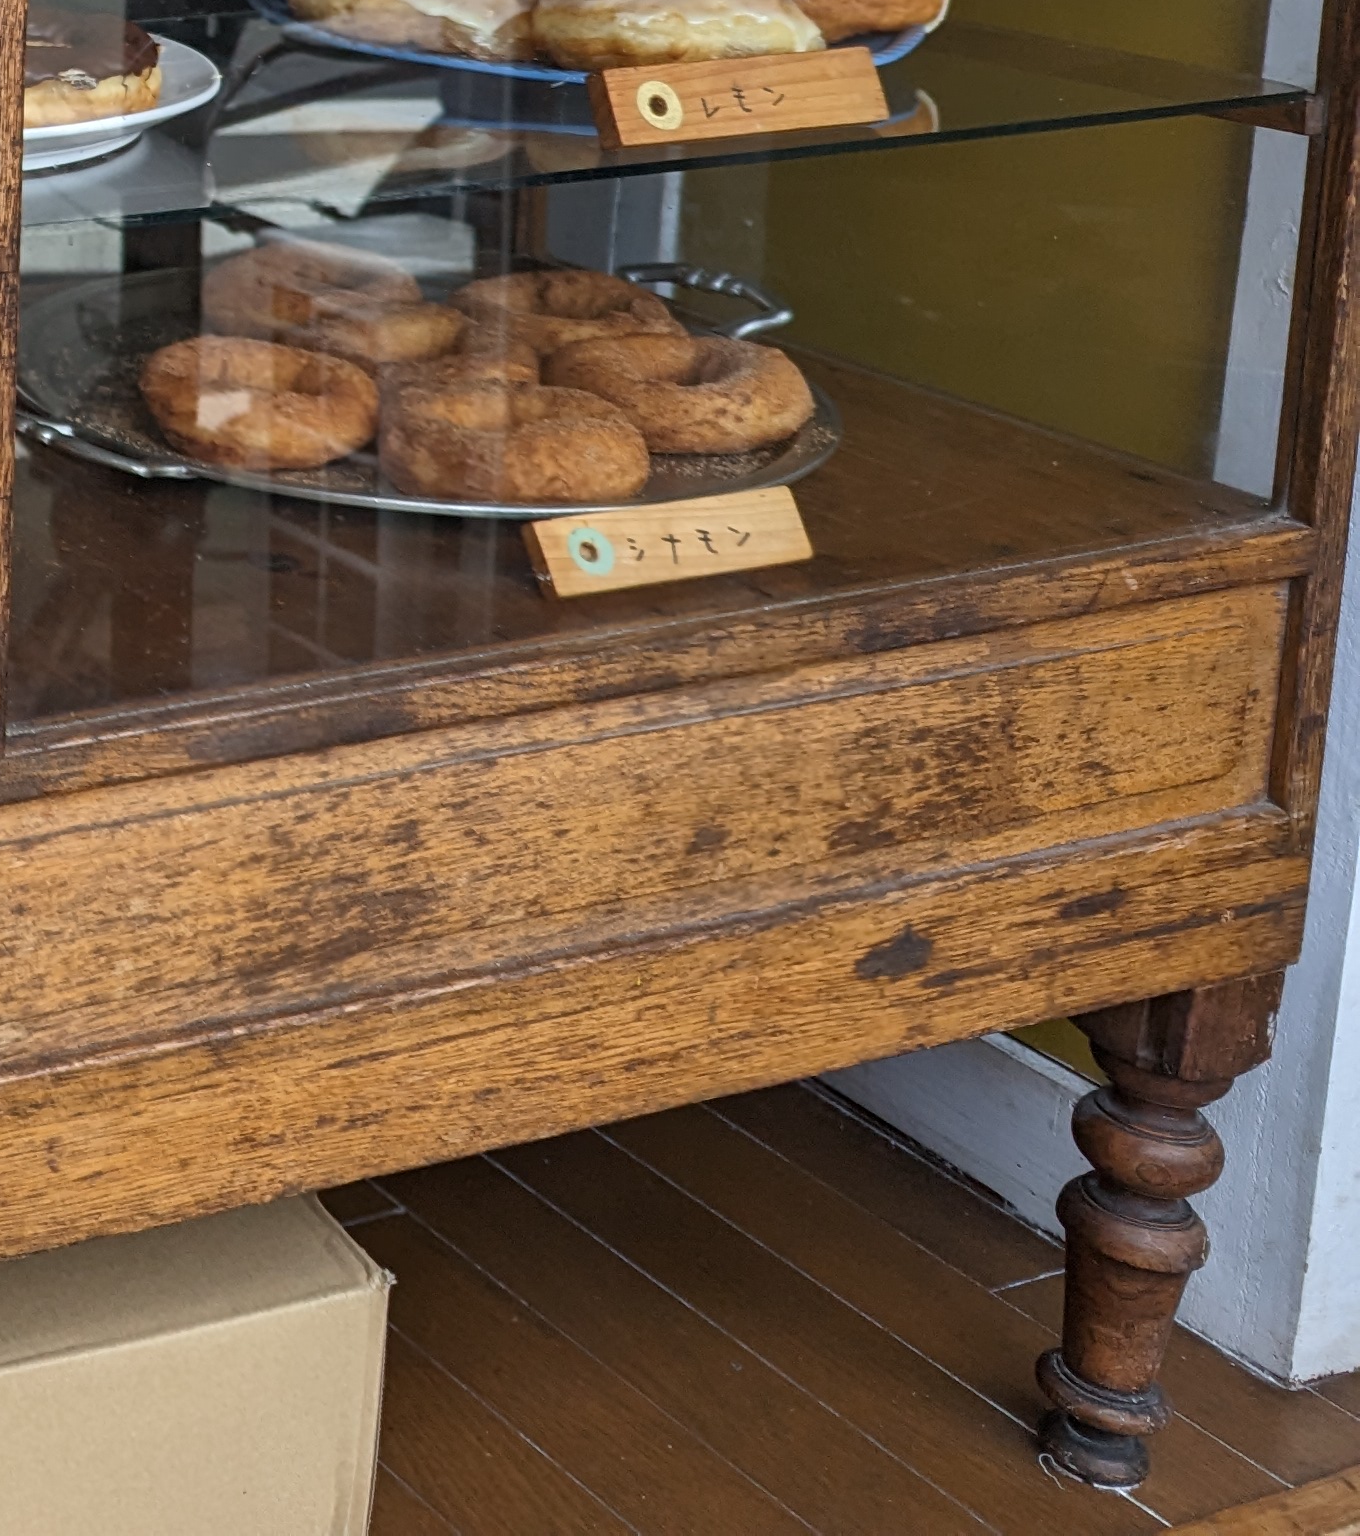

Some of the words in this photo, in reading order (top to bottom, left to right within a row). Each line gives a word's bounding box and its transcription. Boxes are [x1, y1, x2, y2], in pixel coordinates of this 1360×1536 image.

[700, 87, 785, 118] レモン
[626, 526, 751, 565] シナモン
